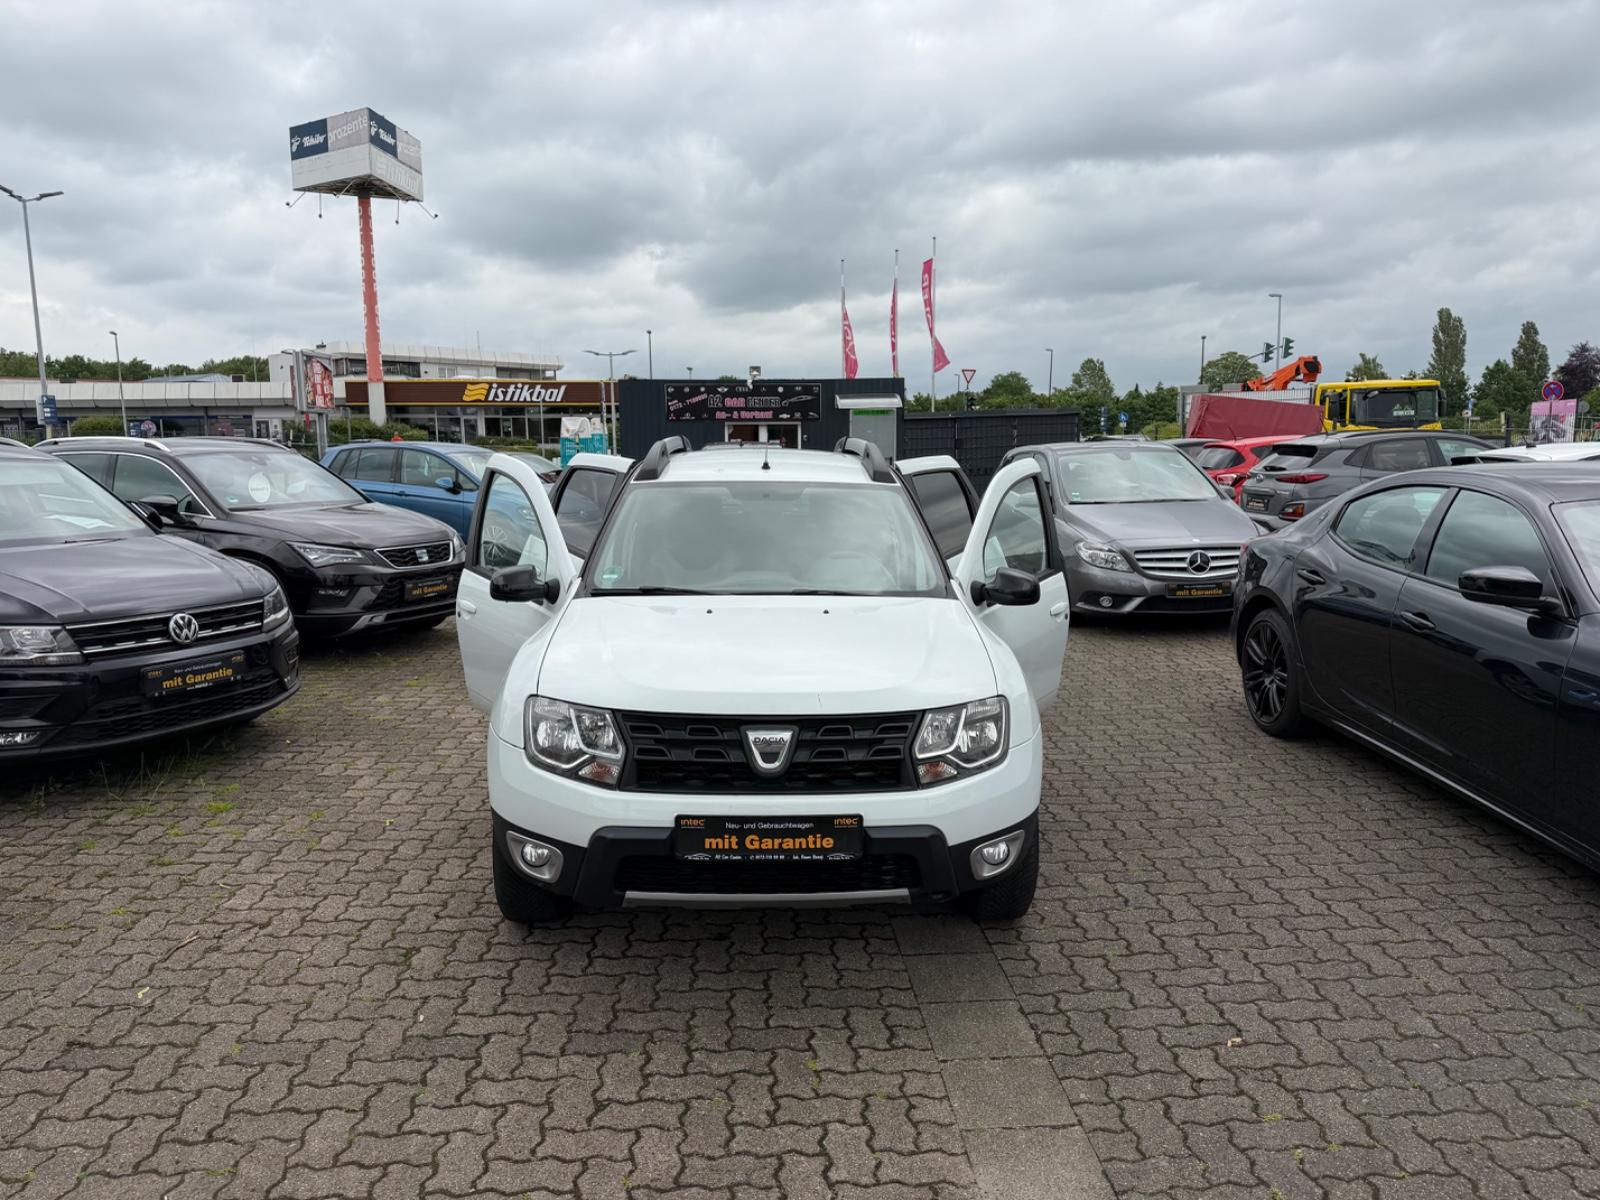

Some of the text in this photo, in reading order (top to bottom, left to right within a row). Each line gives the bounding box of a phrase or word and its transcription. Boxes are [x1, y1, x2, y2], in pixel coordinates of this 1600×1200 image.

[488, 383, 567, 401] istikbal
[162, 677, 184, 689] mit
[186, 667, 233, 684] Garantie
[753, 736, 785, 744] DACIA
[757, 822, 814, 831] Gebrauchtwagen
[704, 834, 834, 850] mit Garantie
